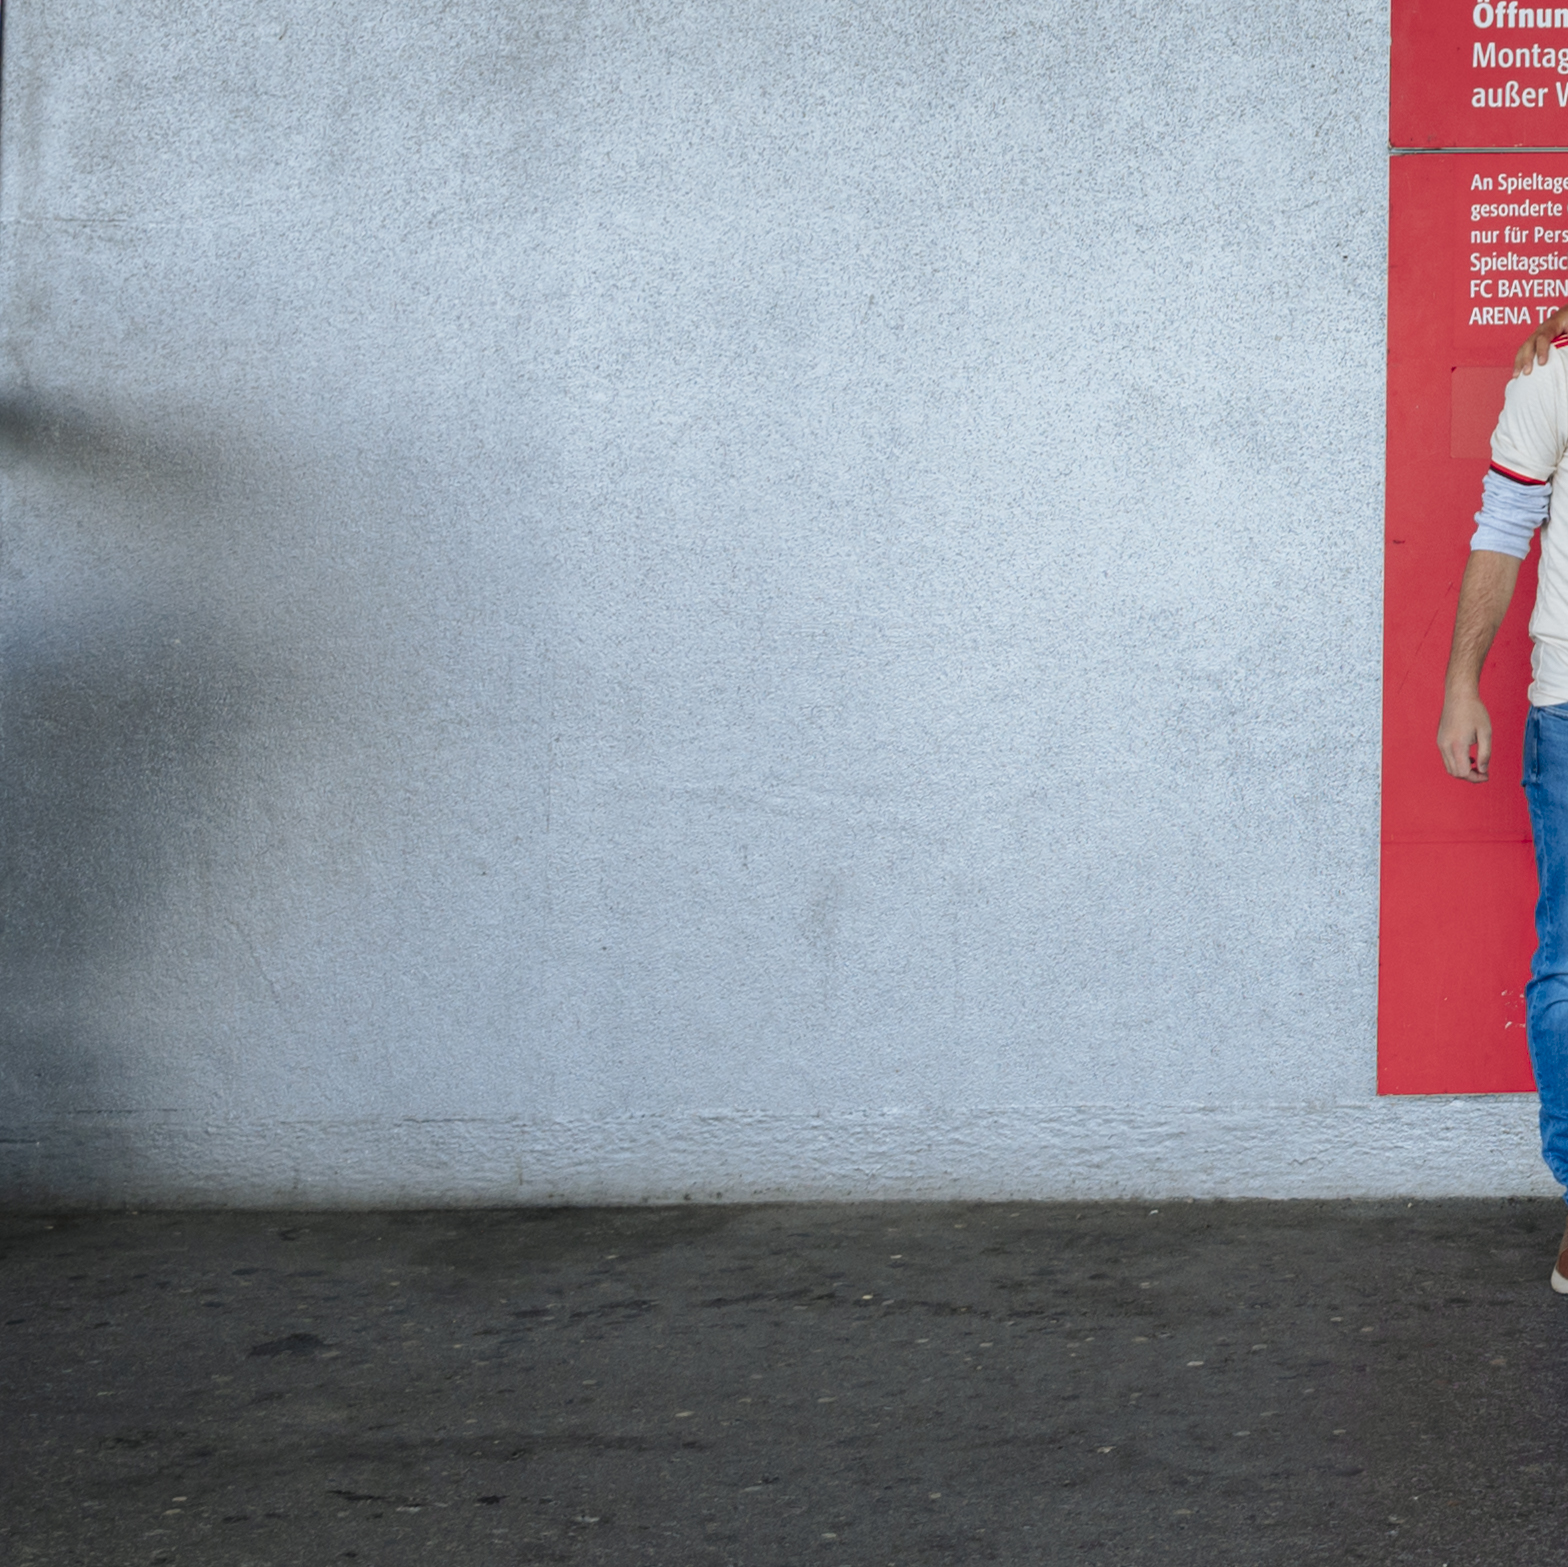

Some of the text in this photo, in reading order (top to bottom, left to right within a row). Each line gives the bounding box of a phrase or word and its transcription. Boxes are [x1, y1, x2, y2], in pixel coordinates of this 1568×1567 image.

[1471, 80, 1549, 108] außer
[1470, 173, 1493, 191] An
[1470, 198, 1563, 222] gesonderte
[1470, 230, 1500, 244] nur
[1504, 225, 1529, 244] für
[1470, 279, 1493, 299] FC
[1498, 279, 1568, 298] BAYERN
[1468, 306, 1532, 326] ARENA
